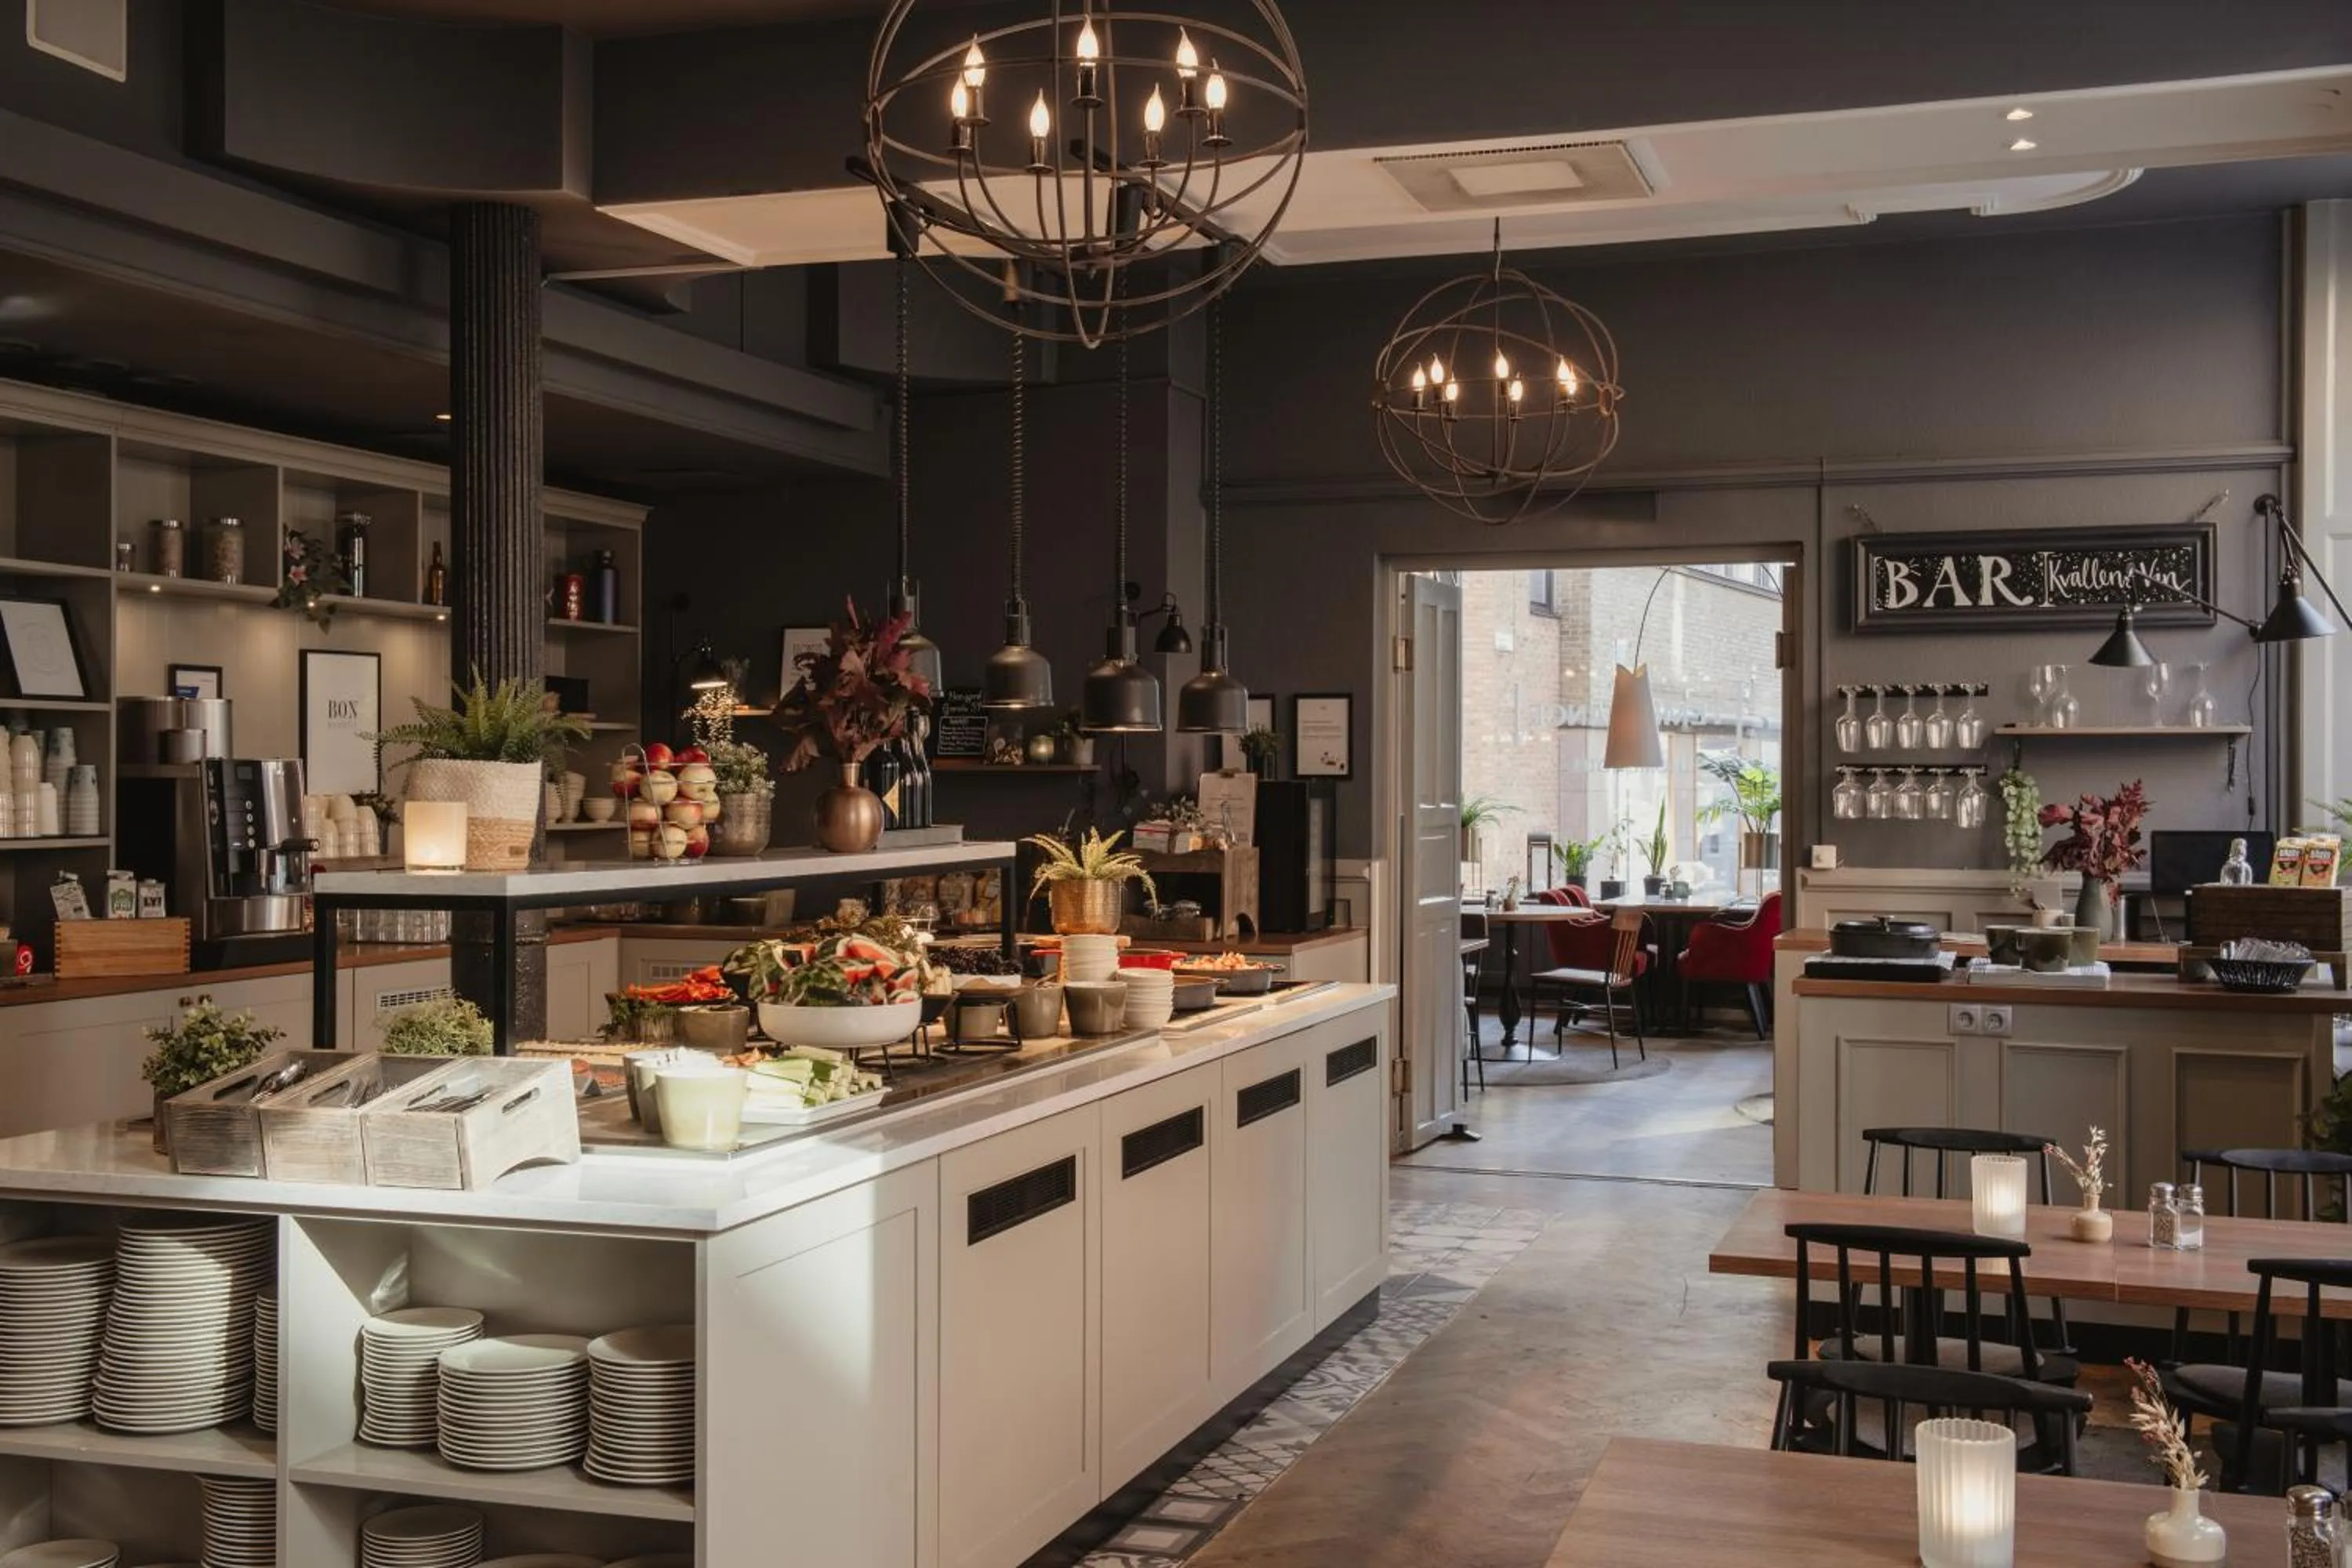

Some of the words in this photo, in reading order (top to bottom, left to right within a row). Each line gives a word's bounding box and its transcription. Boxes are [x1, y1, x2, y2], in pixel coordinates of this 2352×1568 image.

[1884, 554, 2034, 609] BAR
[2139, 557, 2192, 590] Vin
[328, 699, 360, 719] BOX
